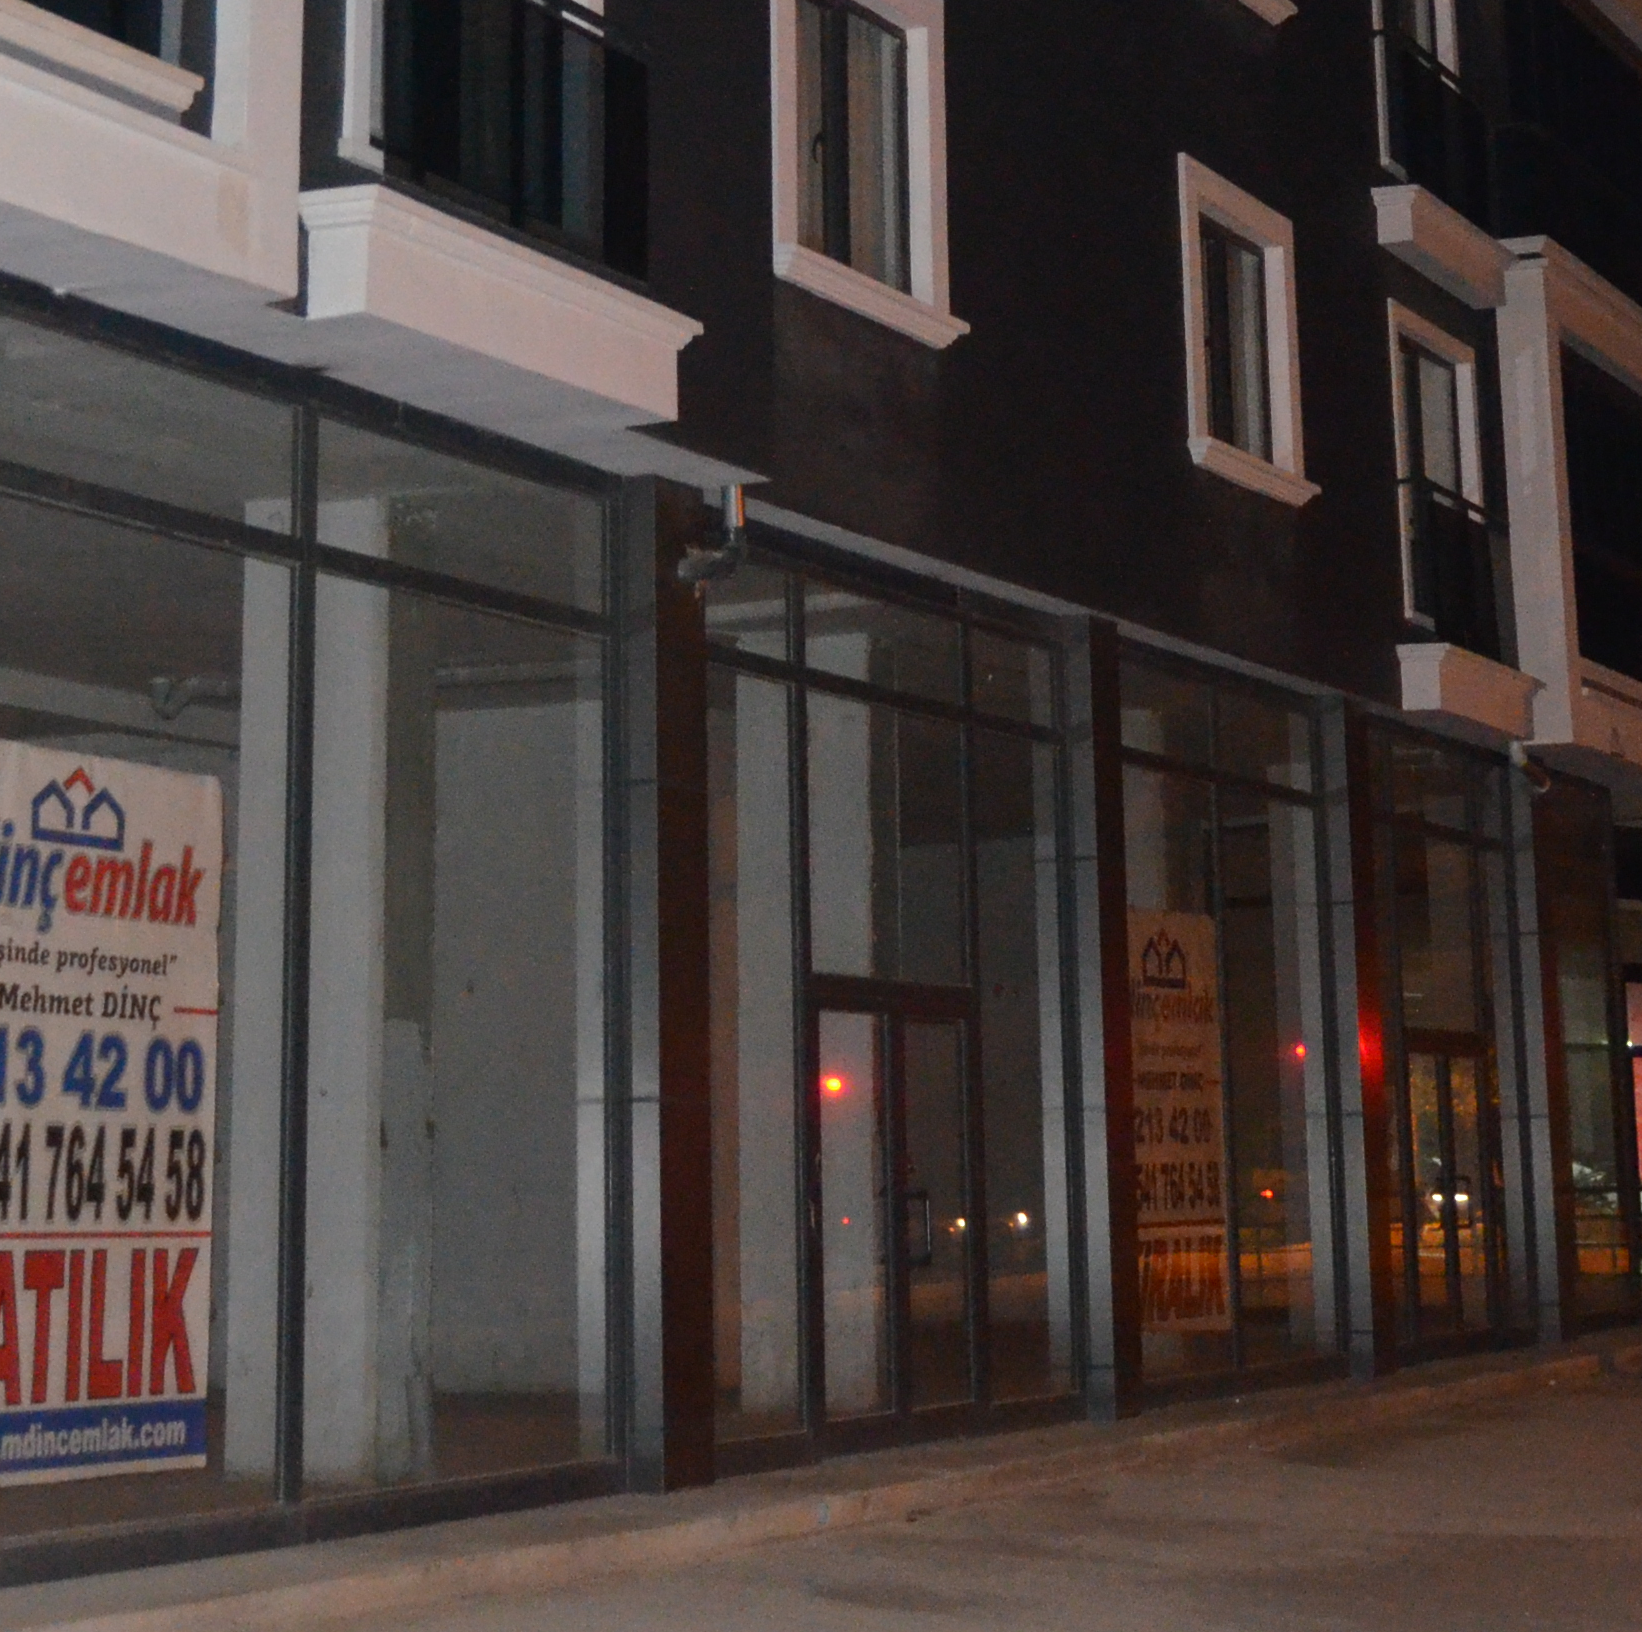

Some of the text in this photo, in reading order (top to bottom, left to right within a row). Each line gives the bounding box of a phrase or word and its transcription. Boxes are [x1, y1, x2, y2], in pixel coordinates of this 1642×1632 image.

[101, 985, 162, 1030] DİNÇ
[61, 1029, 129, 1110] 42
[144, 1037, 205, 1112] 00
[45, 1124, 106, 1221] 764
[115, 1126, 156, 1221] 54
[165, 1128, 206, 1221] 58
